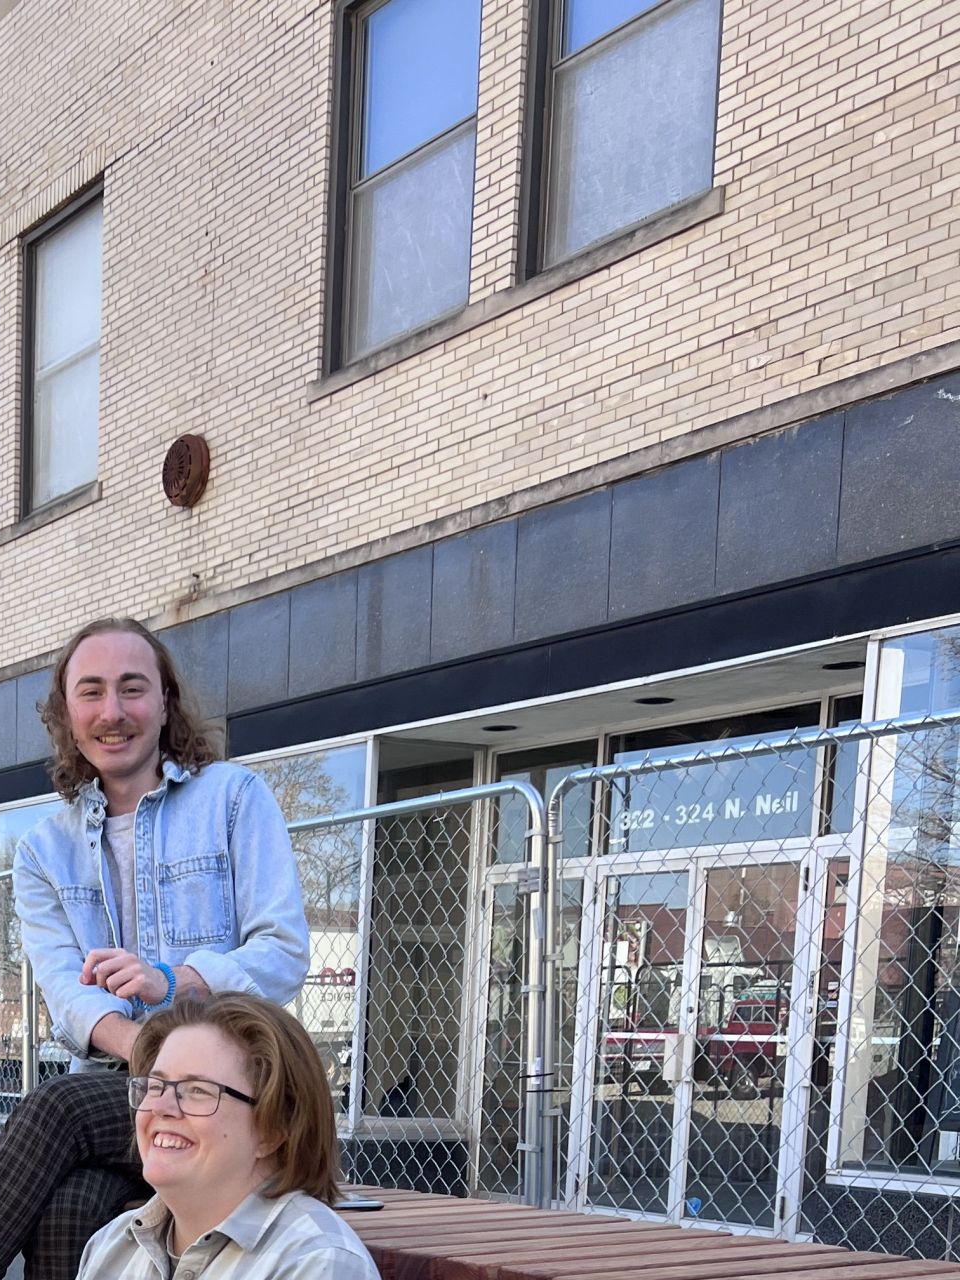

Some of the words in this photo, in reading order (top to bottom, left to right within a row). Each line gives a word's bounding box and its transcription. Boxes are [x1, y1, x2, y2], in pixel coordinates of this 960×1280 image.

[619, 809, 655, 830] 322
[675, 802, 715, 825] 324
[725, 798, 745, 820] N.
[755, 791, 799, 816] Neil
